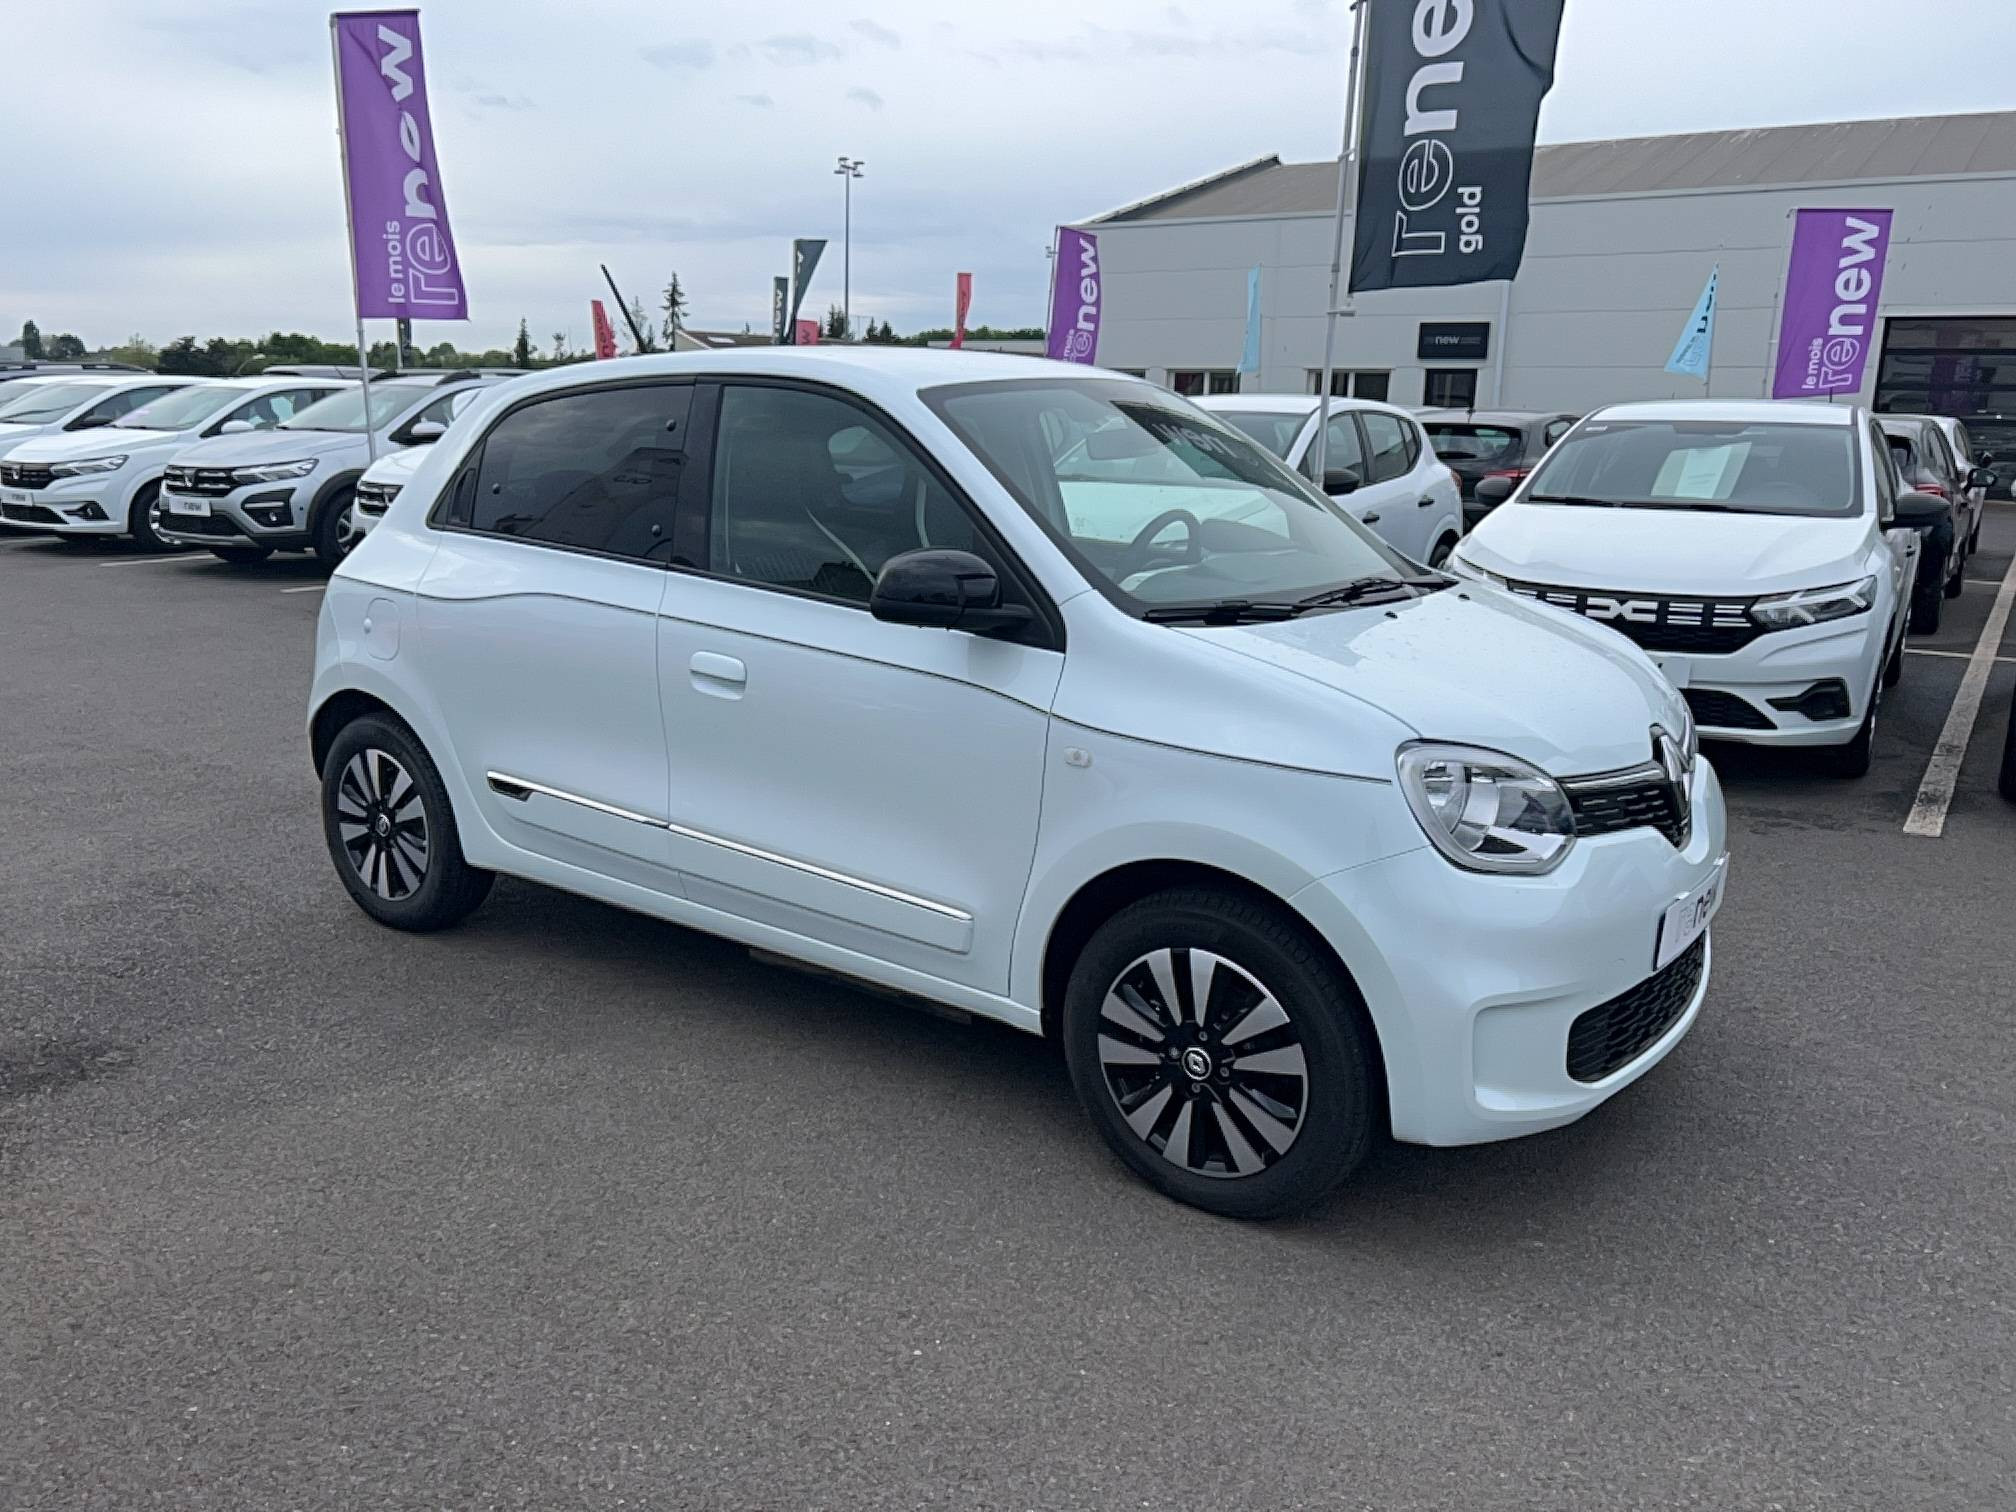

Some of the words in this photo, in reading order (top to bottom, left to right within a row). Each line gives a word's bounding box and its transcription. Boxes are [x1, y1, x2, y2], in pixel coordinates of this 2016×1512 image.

[378, 24, 459, 304] renew
[1455, 186, 1483, 253] gold
[382, 220, 403, 279] mois
[387, 282, 405, 303] le
[1819, 216, 1880, 388] renew
[1801, 376, 1816, 389] le
[1807, 337, 1823, 374] mois
